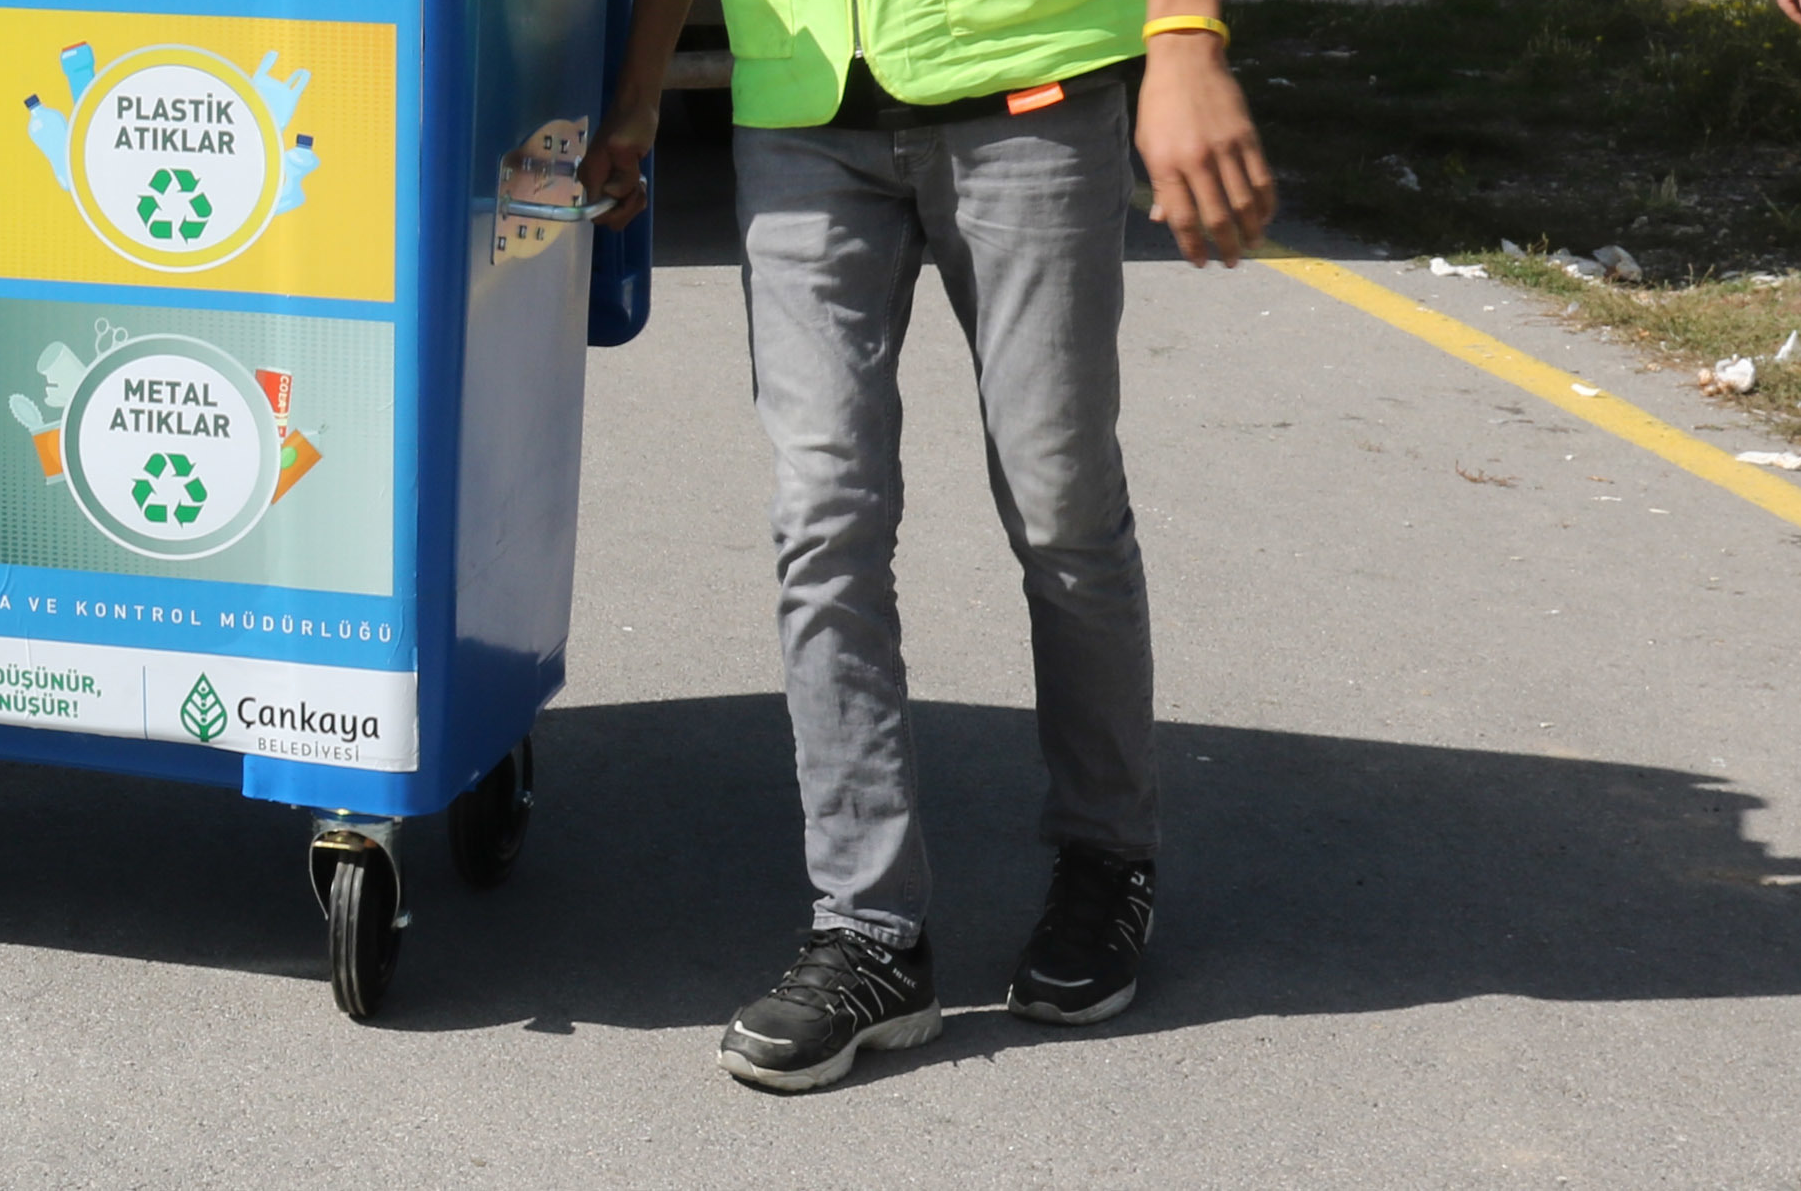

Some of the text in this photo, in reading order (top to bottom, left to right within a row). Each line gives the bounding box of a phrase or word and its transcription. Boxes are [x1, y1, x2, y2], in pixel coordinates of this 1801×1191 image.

[116, 92, 235, 125] PLASTİK
[114, 126, 236, 155] ATIKLAR
[123, 377, 219, 407] METAL
[109, 407, 231, 439] ATIKLAR
[27, 596, 58, 615] VE
[76, 600, 202, 627] KONTROL
[220, 611, 392, 643] MÜDÜRLÜĞÜ
[237, 696, 381, 743] Çankaya
[257, 736, 361, 763] BELEDİYESİ
